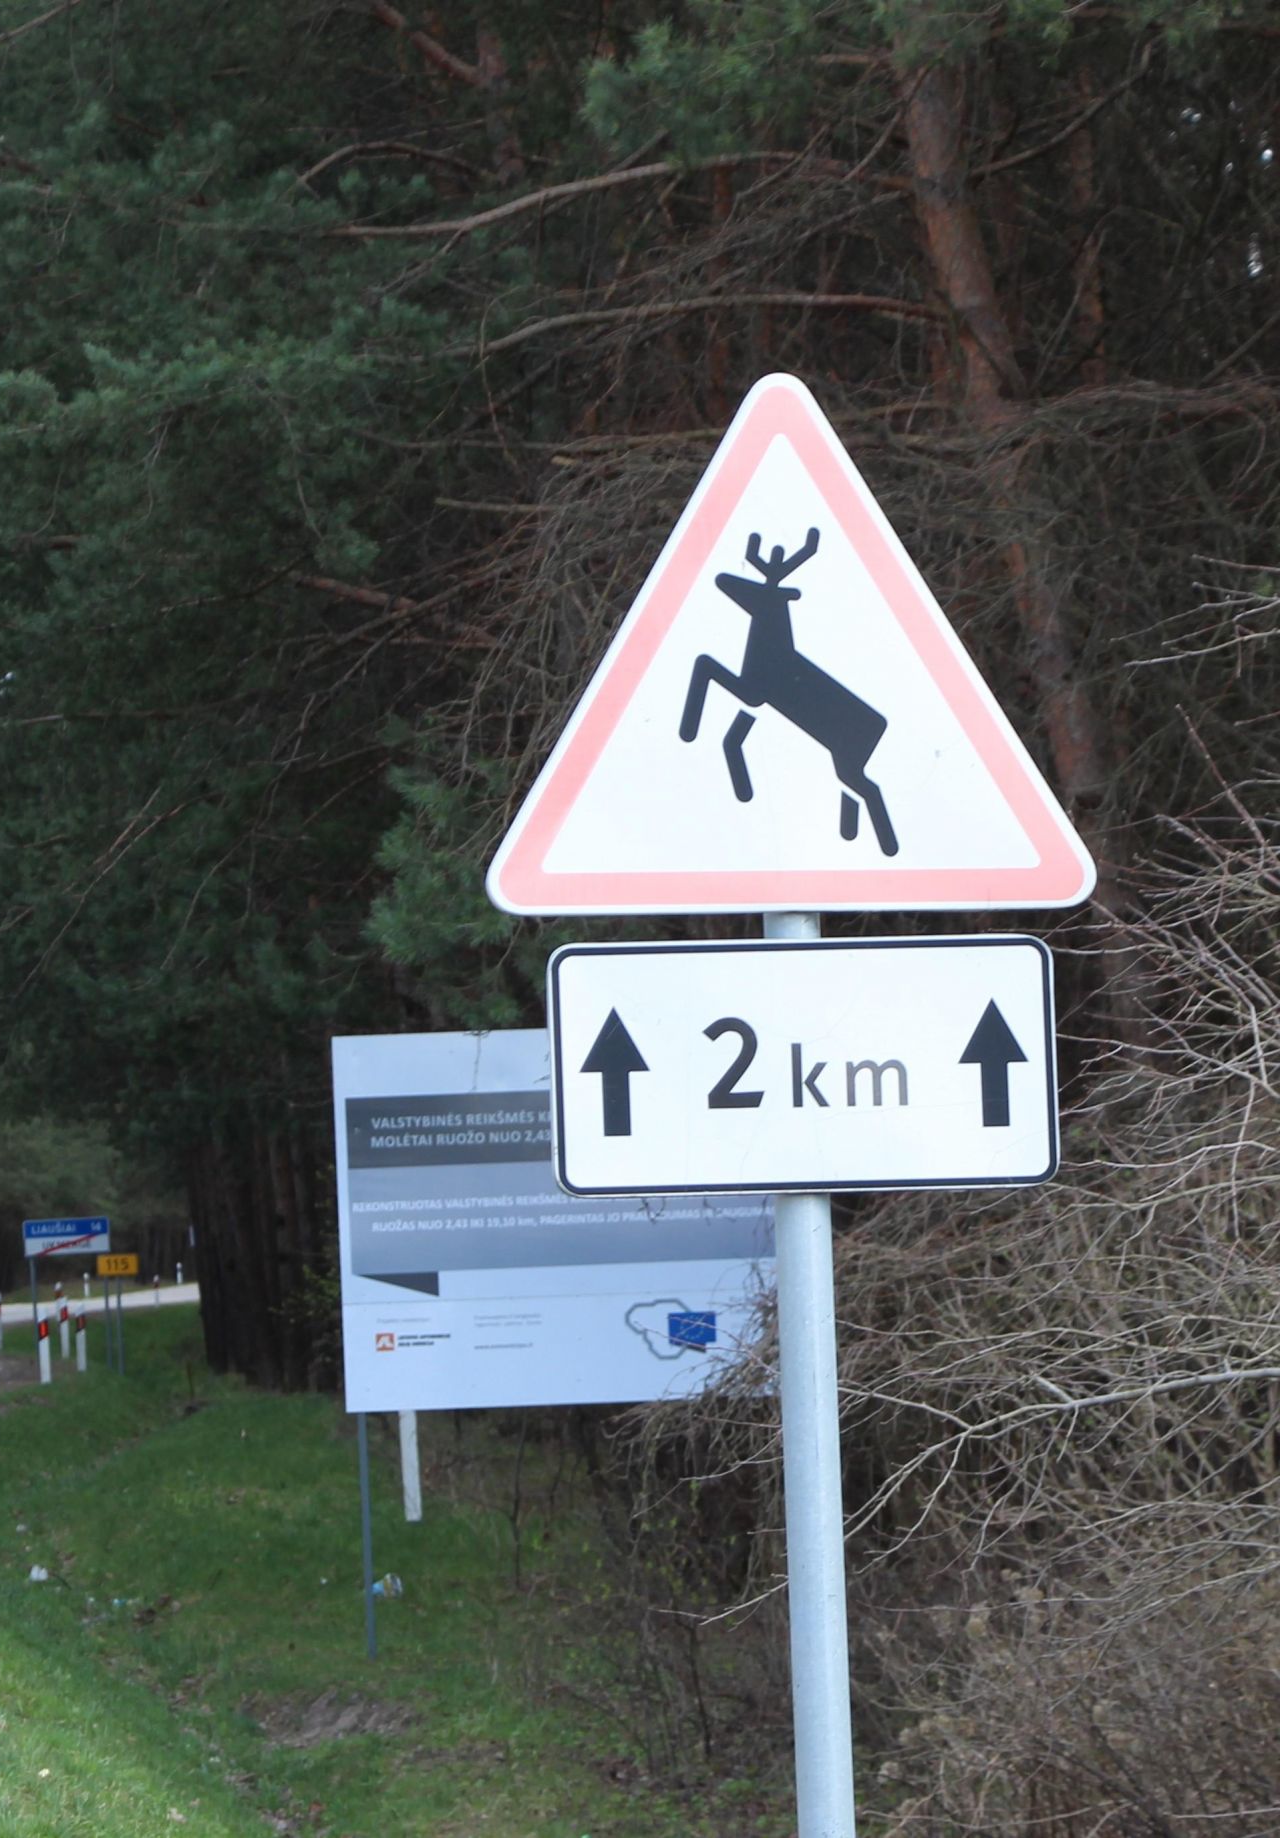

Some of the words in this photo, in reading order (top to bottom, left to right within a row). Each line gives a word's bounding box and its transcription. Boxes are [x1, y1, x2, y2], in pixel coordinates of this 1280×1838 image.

[702, 1016, 764, 1110] 2
[791, 1042, 909, 1109] km
[371, 1112, 463, 1130] VALSTYBINĖS
[466, 1109, 535, 1126] REIKŠMĖS
[370, 1132, 432, 1149] MOLĖTAI
[436, 1129, 485, 1146] RUOŽO
[488, 1130, 521, 1143] NUO
[352, 1199, 442, 1213] REKONSTRUOTAS
[446, 1195, 514, 1209] VALSTYBINĖS
[372, 1219, 415, 1233] RUOŽAS
[418, 1220, 442, 1231] NUO
[106, 1257, 129, 1272] 115
